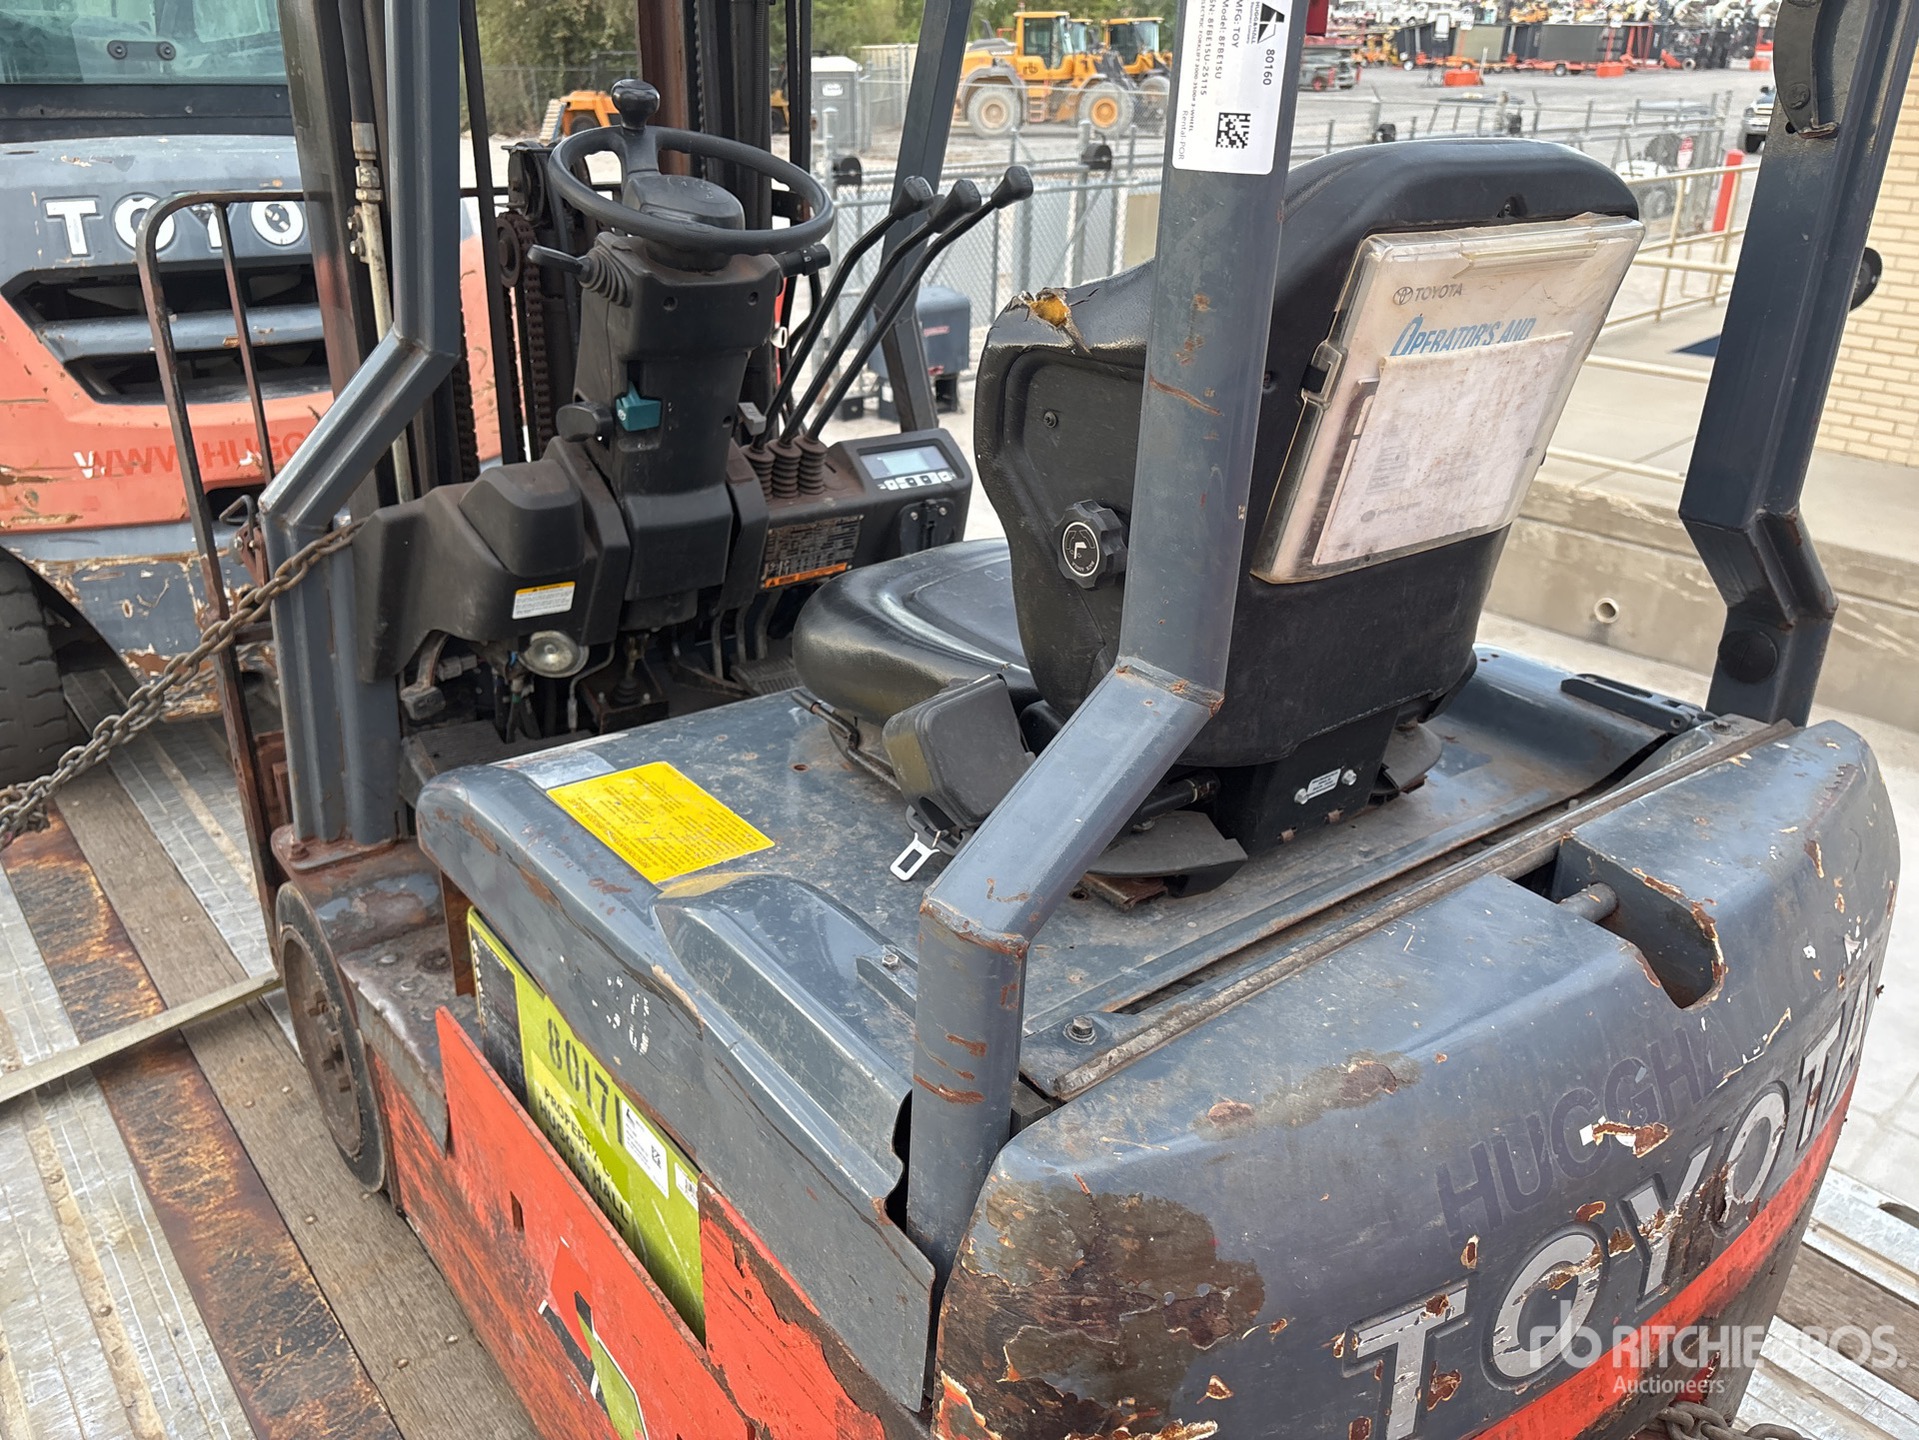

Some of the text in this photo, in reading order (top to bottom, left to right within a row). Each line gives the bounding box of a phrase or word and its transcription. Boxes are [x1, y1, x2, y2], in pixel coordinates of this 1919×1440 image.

[1195, 30, 1204, 62] FORKLIFT
[1214, 0, 1229, 80] Model: 8FBE15U
[1231, 0, 1244, 48] MFG: TOY
[1201, 18, 1214, 96] 8FBE15U-25115
[1262, 48, 1275, 86] 80160
[1178, 110, 1189, 160] Rental-POR
[1415, 283, 1464, 302] TOYOTA
[1500, 317, 1537, 344] AND
[539, 1100, 575, 1154] HUGG
[592, 1167, 629, 1225] HALL
[1352, 964, 1871, 1440] TOYOTA
